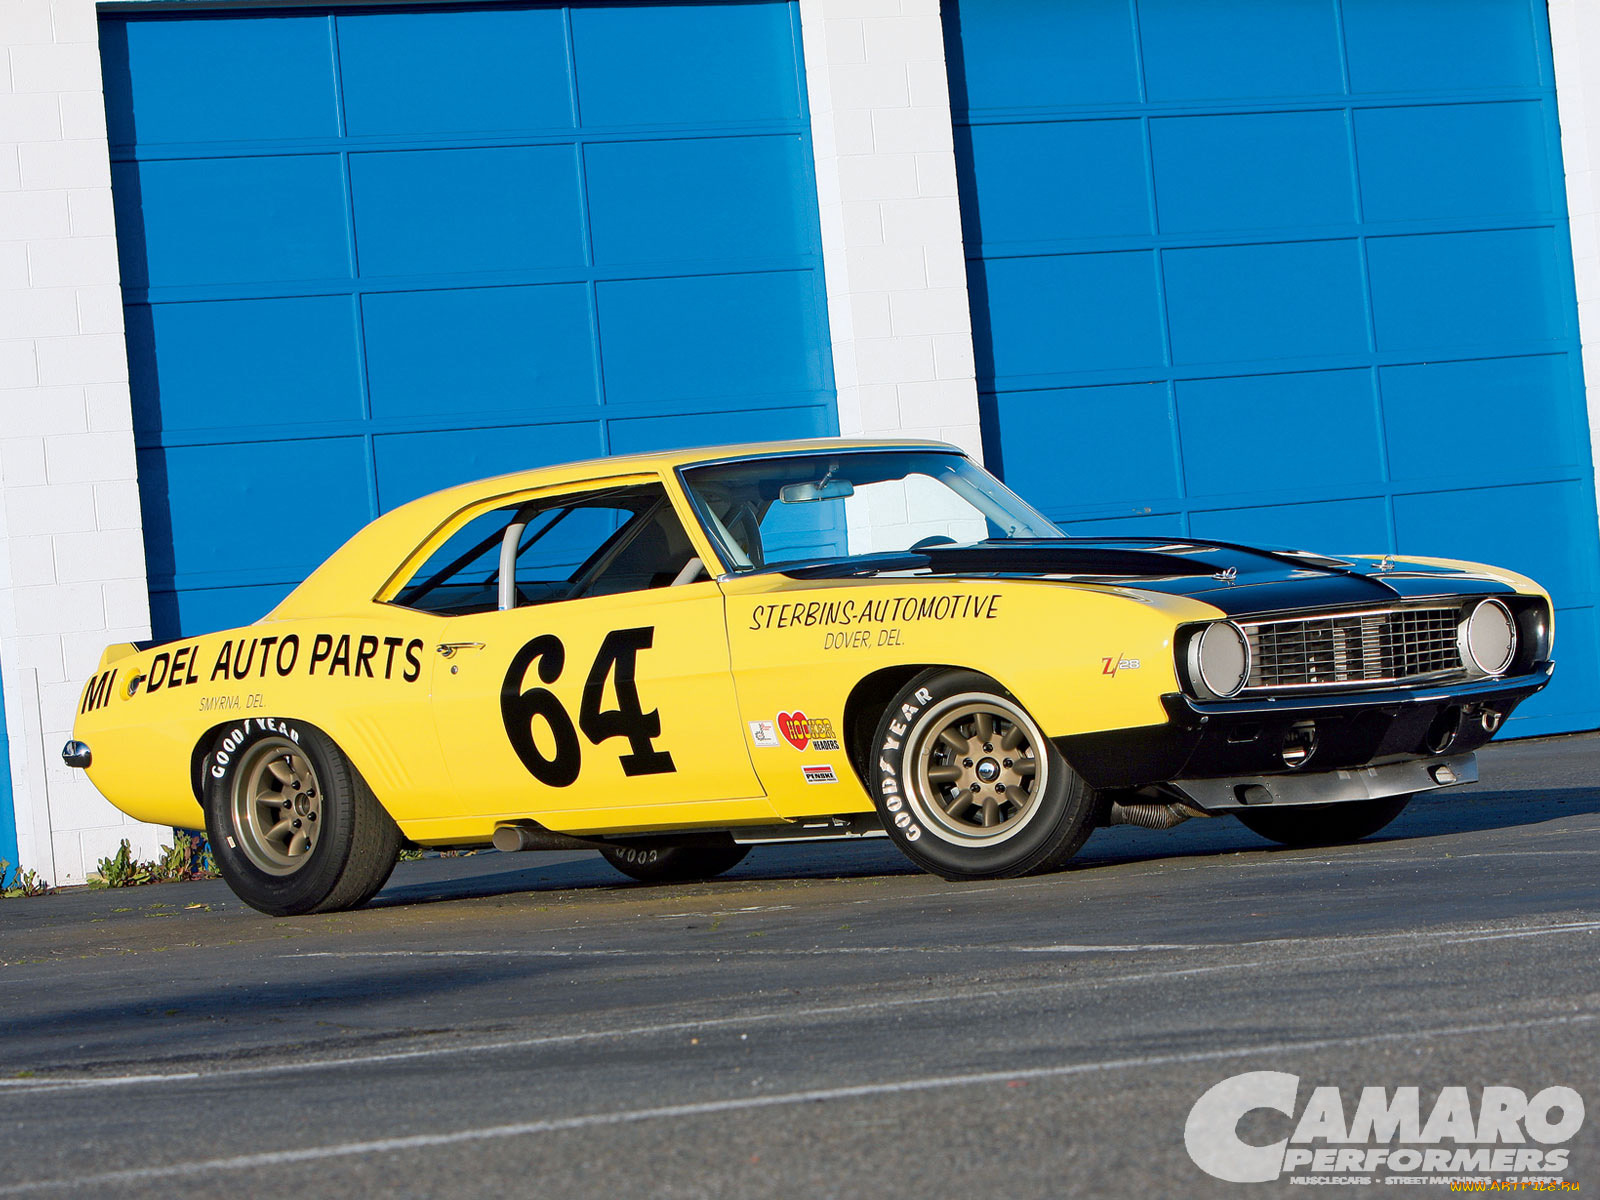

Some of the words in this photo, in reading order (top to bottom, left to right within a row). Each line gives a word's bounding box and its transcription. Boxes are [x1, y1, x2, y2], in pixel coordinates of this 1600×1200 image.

[749, 594, 1003, 631] STERBINS-AUTOMOTIVE
[824, 630, 872, 650] DOVER,
[878, 628, 905, 647] DEL.
[210, 634, 300, 682] AUTO
[308, 633, 424, 683] PARTS
[1101, 652, 1141, 679] Z/28
[500, 626, 677, 788] 64
[786, 718, 837, 740] HOOKER
[812, 740, 840, 751] HEADERS
